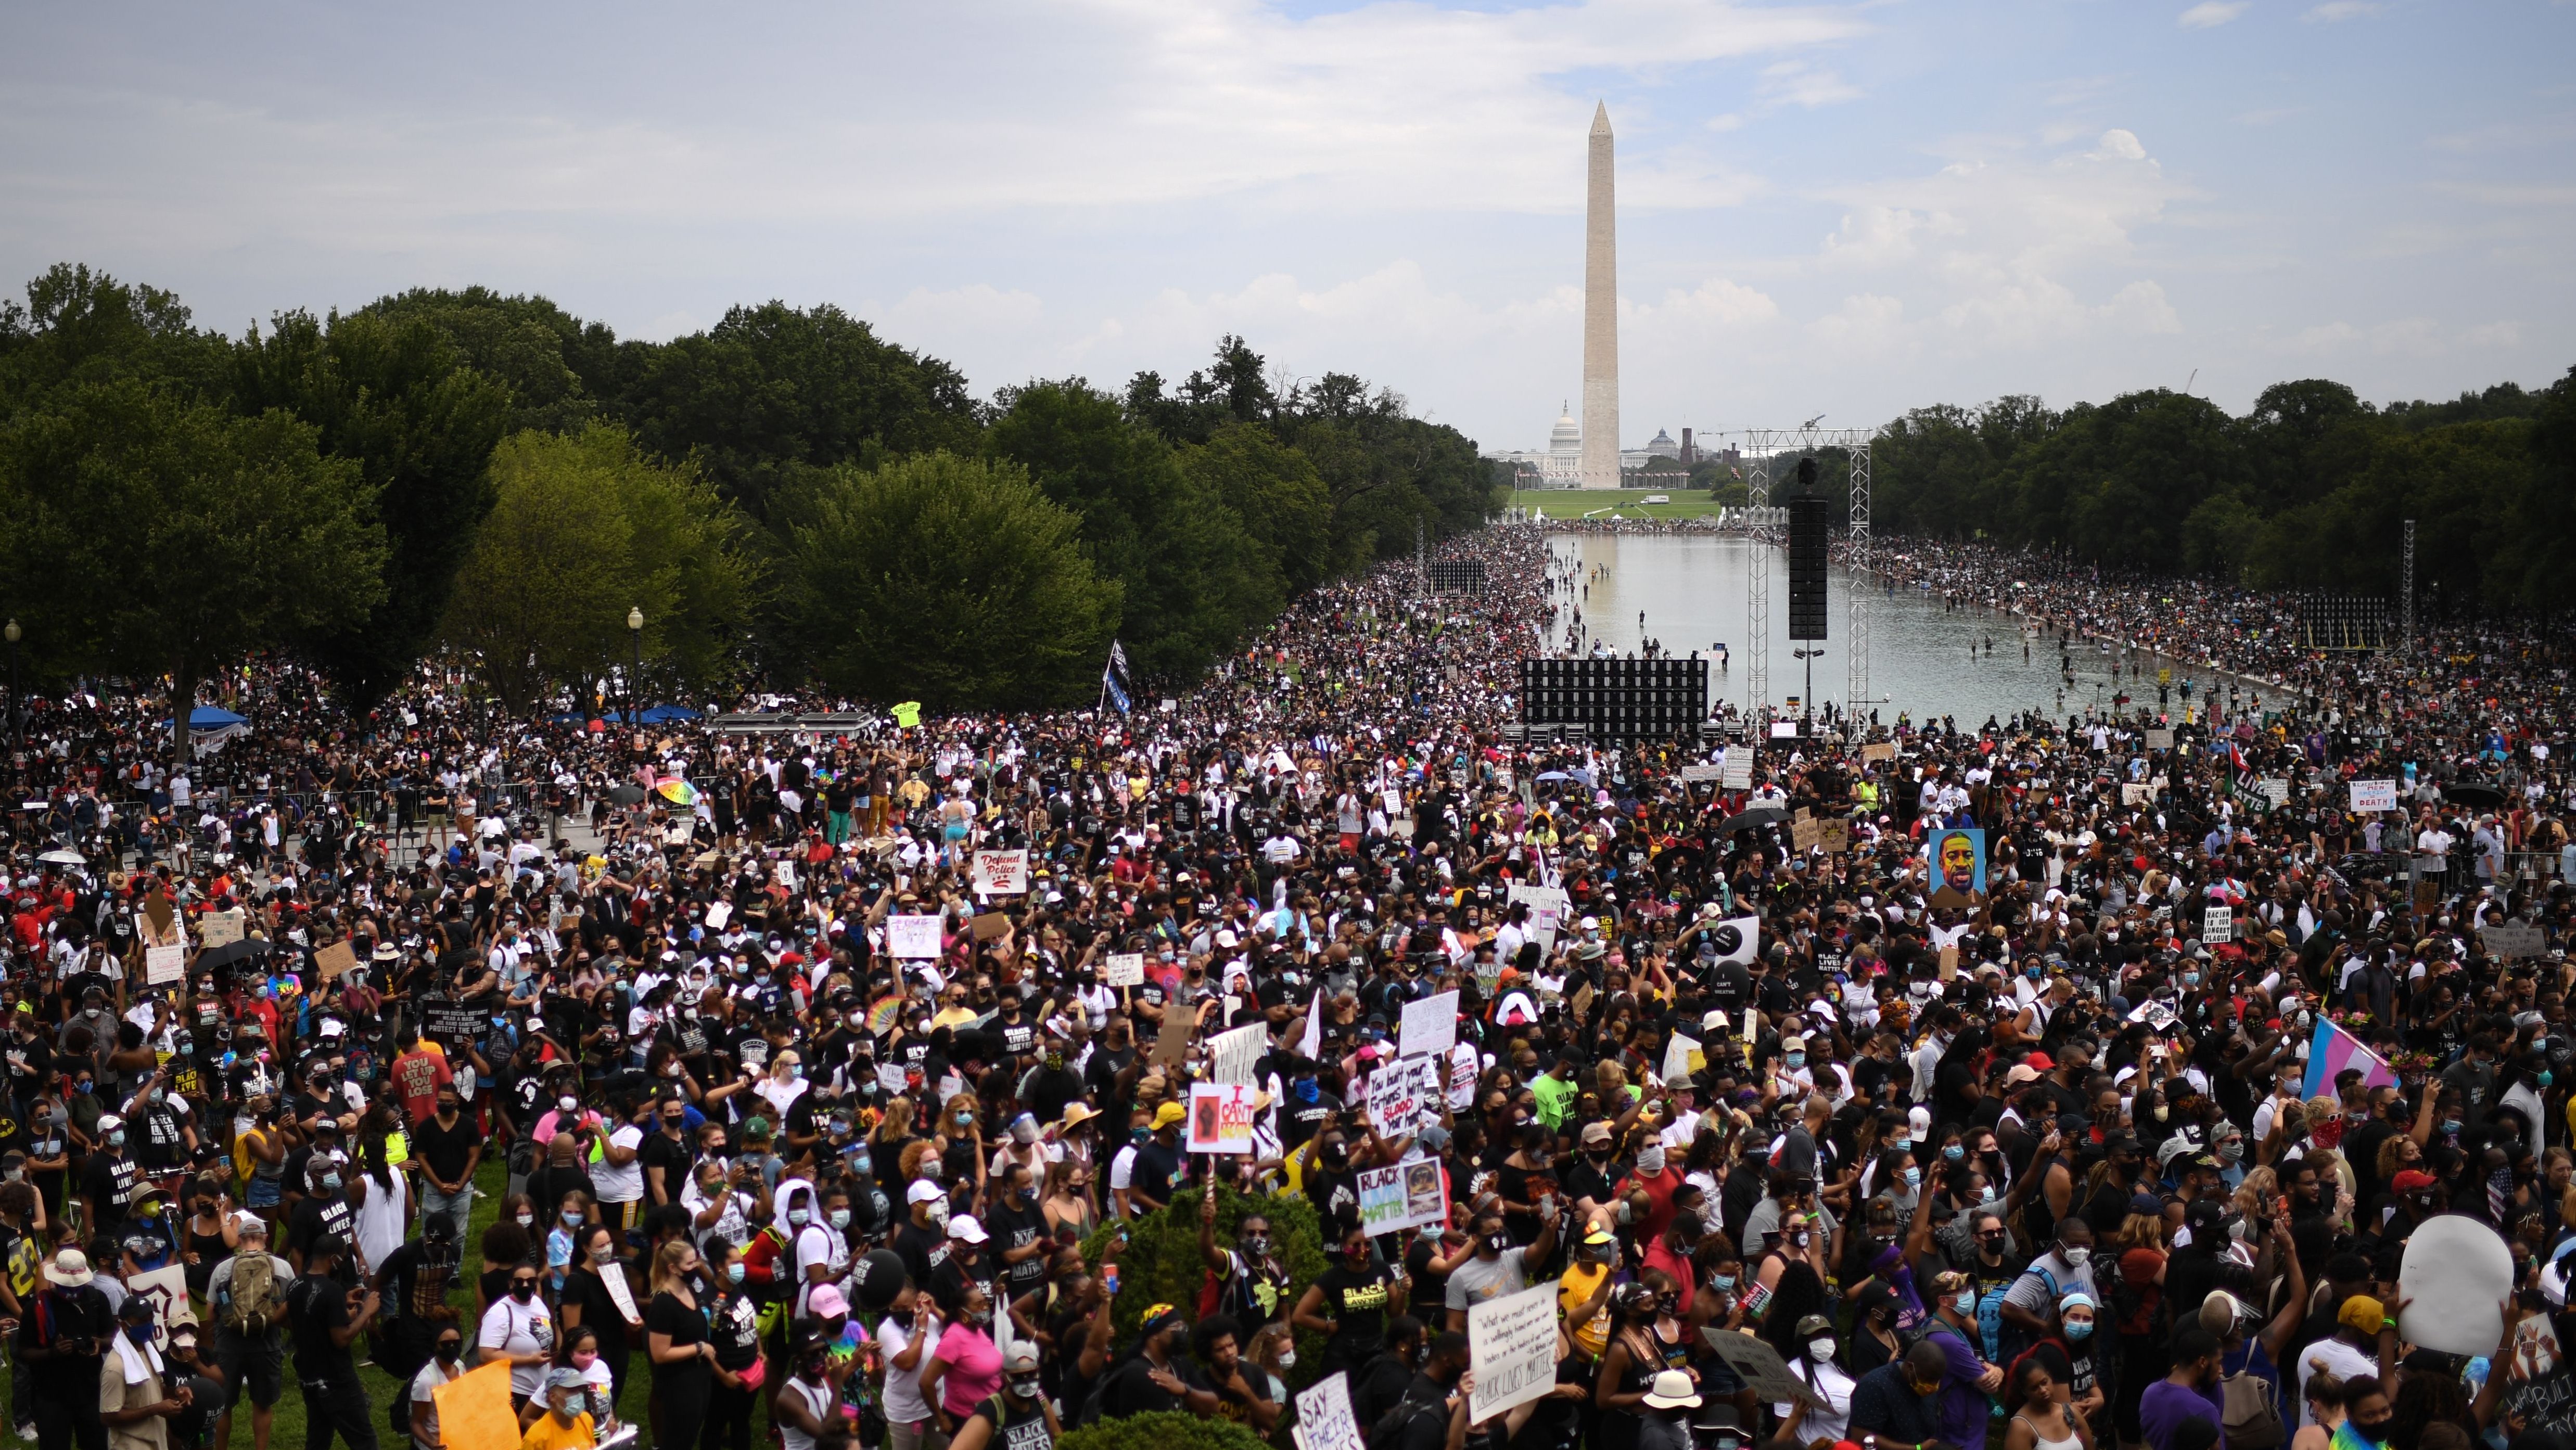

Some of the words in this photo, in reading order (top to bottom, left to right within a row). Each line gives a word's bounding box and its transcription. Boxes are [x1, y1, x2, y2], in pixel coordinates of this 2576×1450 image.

[2237, 771, 2267, 797] LIVE
[668, 789, 691, 800] MATTER
[981, 854, 1020, 866] Defund
[986, 865, 1017, 876] Police
[1520, 887, 1542, 896] FUCK
[1541, 898, 1562, 910] TRUMP
[173, 912, 183, 928] BLM
[1716, 936, 1730, 947] BREATHE
[1479, 986, 1495, 999] BLA
[472, 1024, 487, 1033] VOTE
[1004, 1026, 1031, 1037] BLACK
[1009, 1034, 1031, 1044] LIVES
[403, 1057, 429, 1070] YOU
[741, 1051, 767, 1062] BLACK
[401, 1069, 419, 1082] LET
[420, 1066, 436, 1076] UP
[887, 1068, 900, 1079] The
[1371, 1075, 1384, 1095] You
[1386, 1066, 1405, 1088] built
[1406, 1062, 1427, 1086] your
[409, 1076, 430, 1088] YOU
[407, 1085, 433, 1098] LOSE
[1231, 1086, 1244, 1103] I
[1370, 1086, 1401, 1114] Fortunes
[1302, 1108, 1328, 1117] UNDER
[1383, 1098, 1413, 1122] BLOOD
[1386, 1115, 1401, 1136] your
[110, 1161, 136, 1176] BLACK
[117, 1176, 134, 1189] LIVE
[1360, 1167, 1401, 1192] BLACK
[112, 1191, 131, 1204] MAT
[1361, 1183, 1404, 1210] LIVES
[321, 1201, 349, 1221] BLACK
[1362, 1200, 1405, 1226] MATTER
[329, 1217, 350, 1234] LIVES
[1014, 1232, 1036, 1248] BLACK
[929, 1246, 950, 1267] BLACK
[1343, 1285, 1385, 1298] BLACK
[1345, 1293, 1388, 1306] LAWYERS
[1501, 1314, 1510, 1324] we
[1512, 1306, 1525, 1320] must
[1526, 1301, 1539, 1313] never
[1540, 1296, 1546, 1306] do
[1483, 1338, 1488, 1347] is
[1491, 1326, 1513, 1343] willingly
[1514, 1321, 1526, 1333] hand
[1517, 1338, 1531, 1350] bodies
[1531, 1333, 1535, 1342] of
[1476, 1375, 1500, 1409] BLACK
[1502, 1364, 1523, 1395] LIVES
[1526, 1349, 1552, 1383] MATTER
[2506, 1385, 2534, 1412] WHO
[2532, 1374, 2573, 1411] BUILT
[1303, 1388, 1327, 1428] SAY
[2532, 1411, 2549, 1425] THIS
[1007, 1420, 1044, 1445] BLACK
[1310, 1409, 1350, 1450] THEIR
